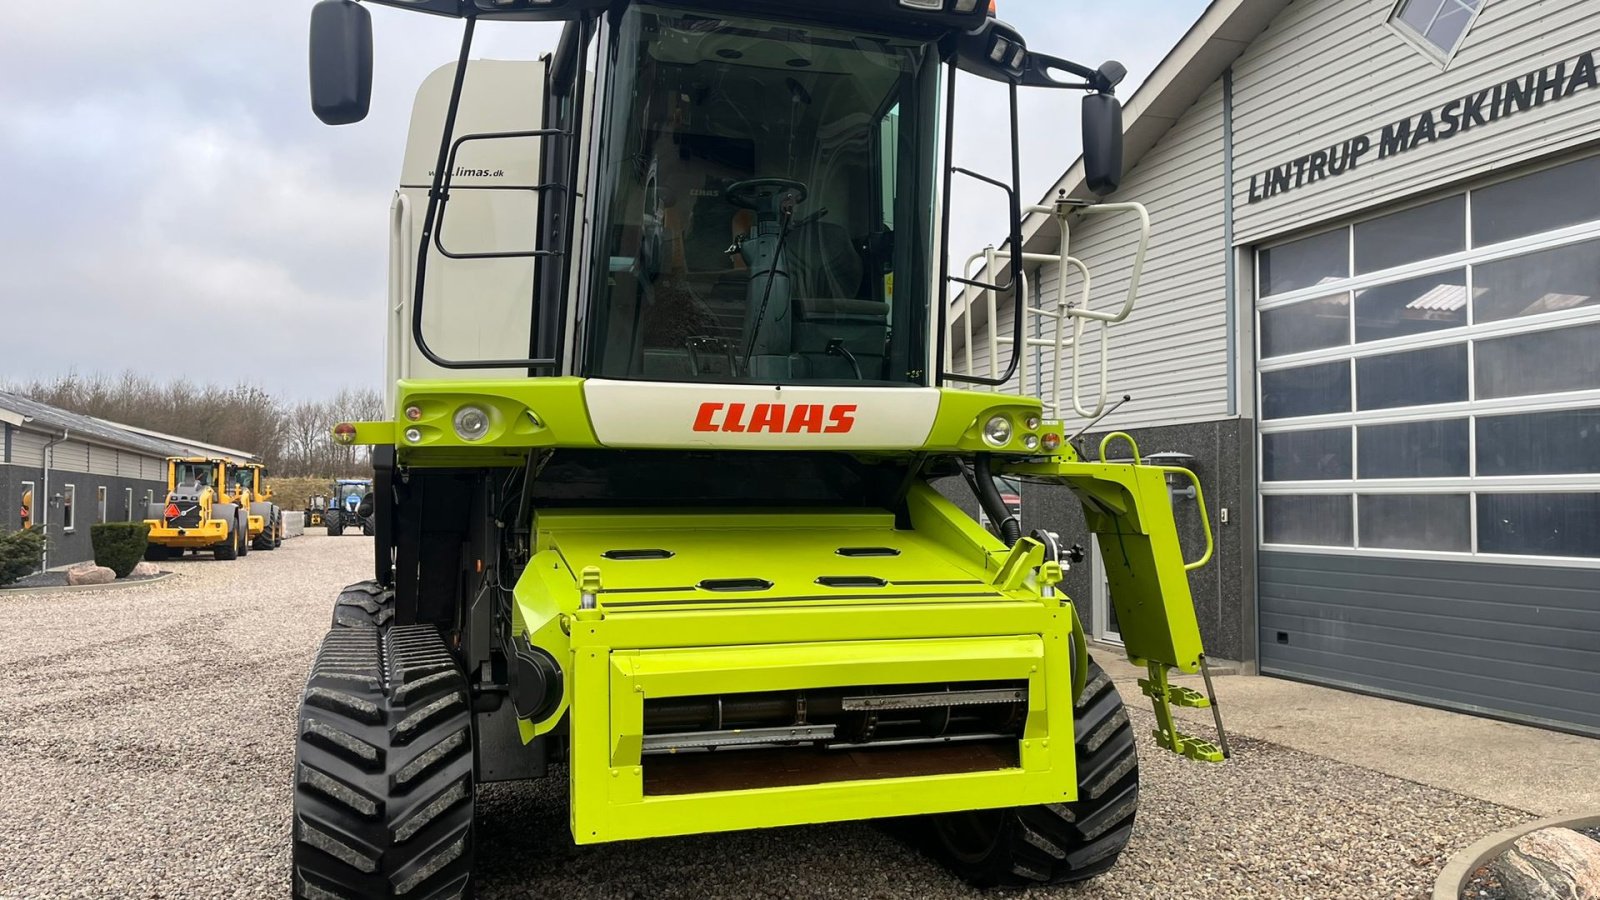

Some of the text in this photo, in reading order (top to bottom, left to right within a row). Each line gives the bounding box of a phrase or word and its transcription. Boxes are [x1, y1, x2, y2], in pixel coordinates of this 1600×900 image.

[1248, 50, 1598, 204] LINTRUP MASKINHA
[428, 166, 504, 177] w.limas.dk
[692, 402, 858, 433] CLAAS
